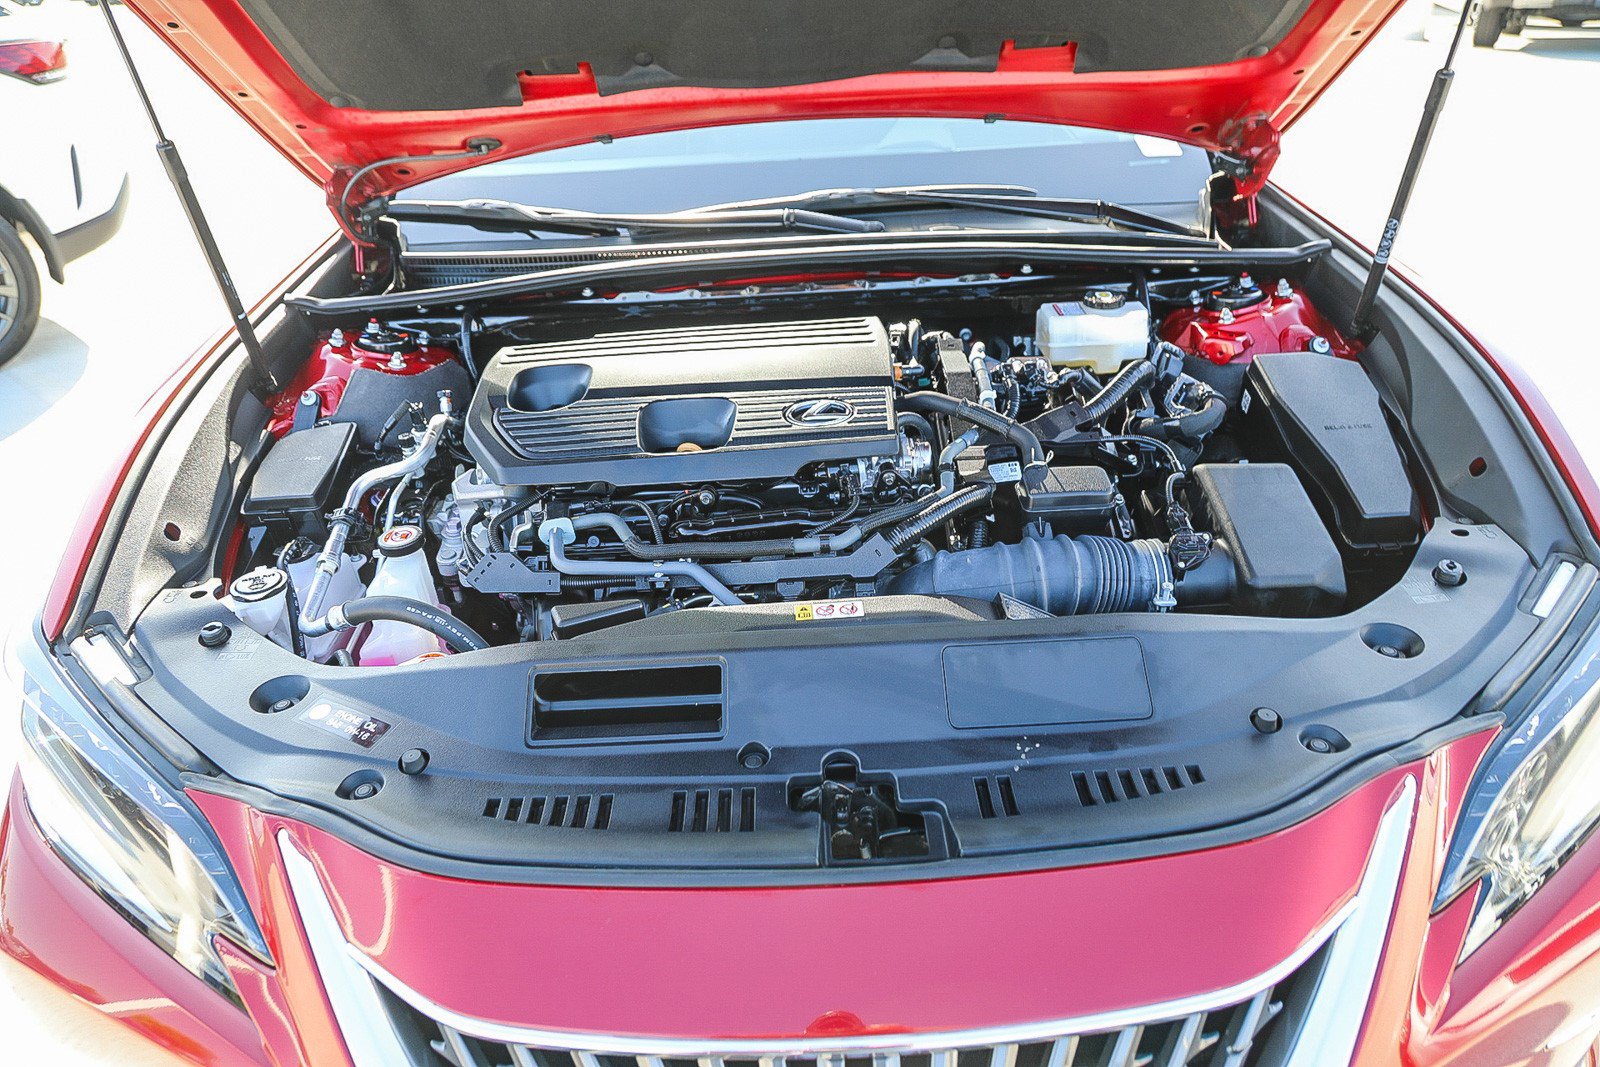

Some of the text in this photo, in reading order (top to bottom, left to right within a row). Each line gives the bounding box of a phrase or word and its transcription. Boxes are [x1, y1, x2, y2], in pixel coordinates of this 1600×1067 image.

[325, 718, 344, 729] SAE
[335, 710, 378, 732] ENGINE OIL
